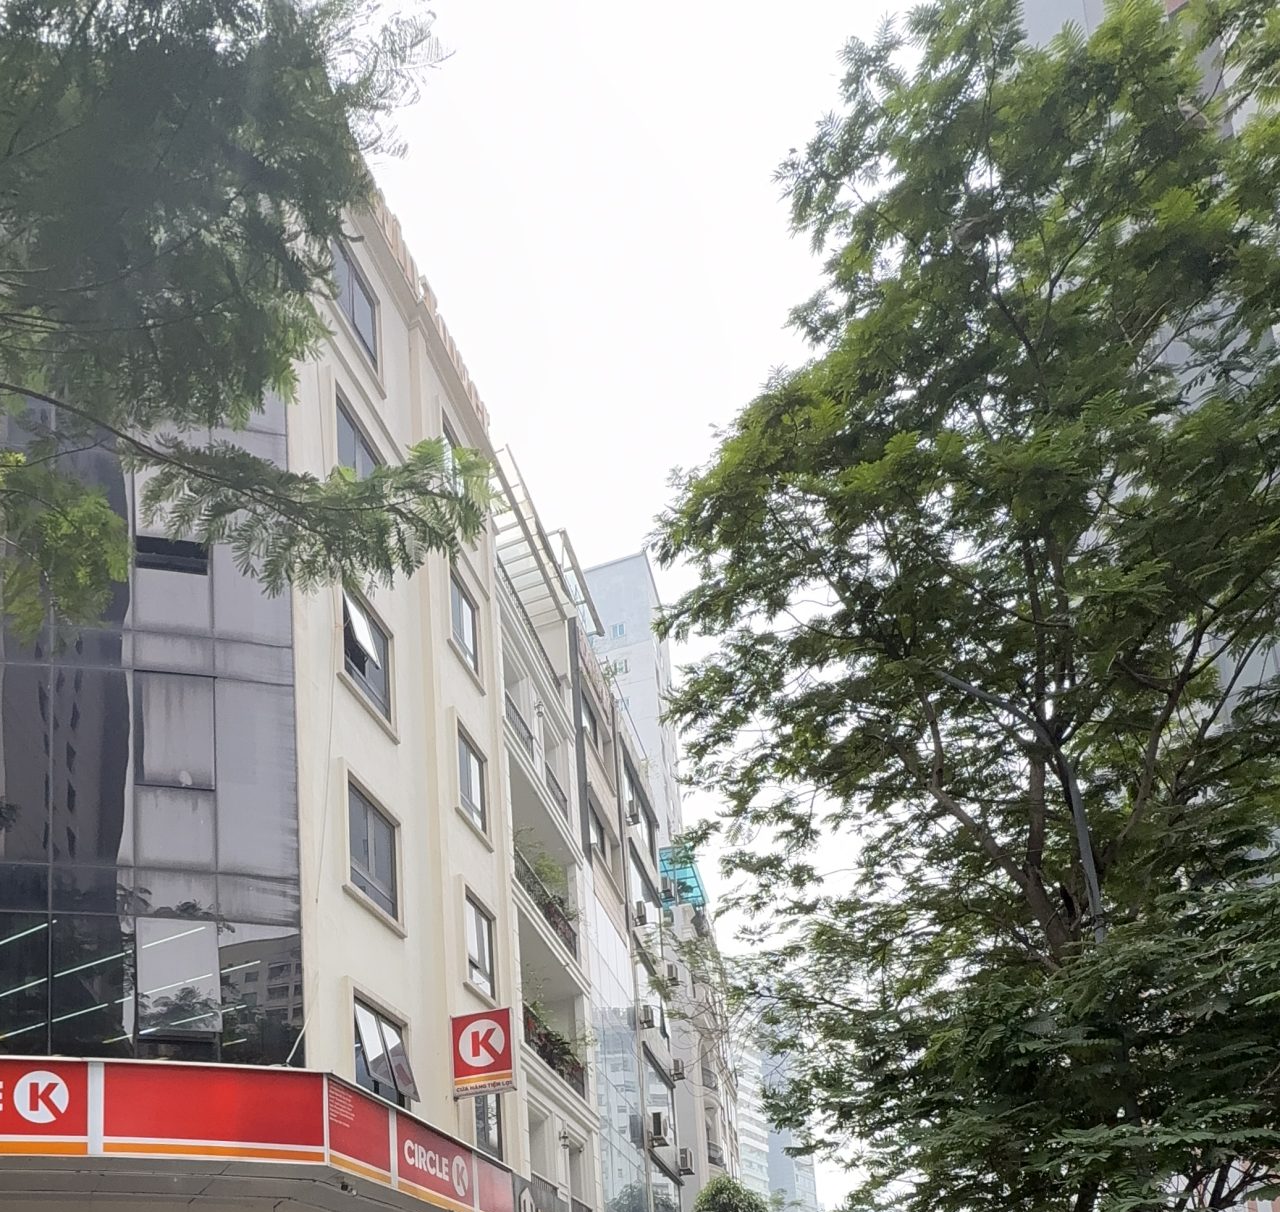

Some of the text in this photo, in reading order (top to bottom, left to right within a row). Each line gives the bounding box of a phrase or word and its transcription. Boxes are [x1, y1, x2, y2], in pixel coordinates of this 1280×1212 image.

[464, 1023, 505, 1065] K
[18, 1072, 68, 1123] K
[404, 1139, 469, 1197] CIRCLE K
